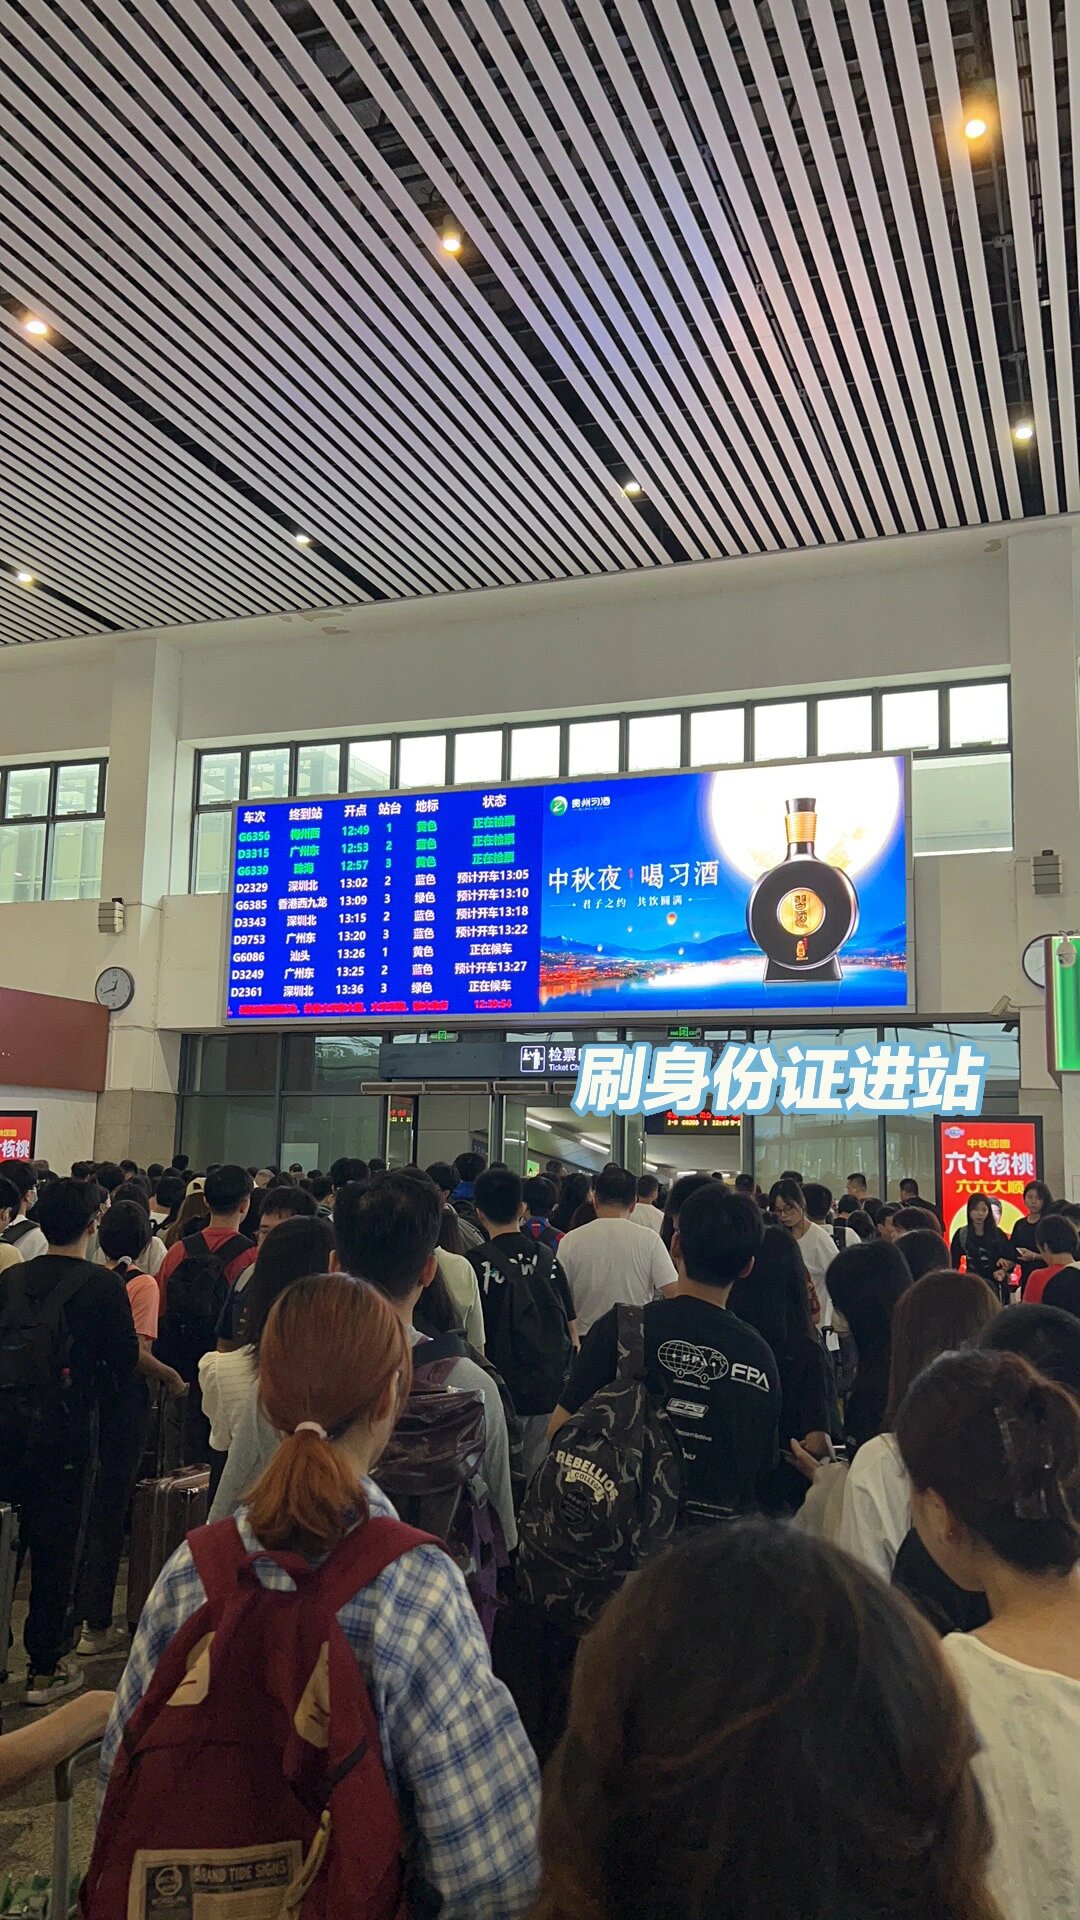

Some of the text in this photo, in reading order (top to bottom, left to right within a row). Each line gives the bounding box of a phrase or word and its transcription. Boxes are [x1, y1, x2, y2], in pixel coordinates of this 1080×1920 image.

[243, 794, 506, 824] 车次 终到站 开点 站台 地标 状态
[238, 831, 270, 842] G6356
[342, 825, 369, 836] 12:49
[386, 823, 392, 832] 1
[473, 815, 515, 829] 正在检票
[237, 848, 269, 859] D3315
[290, 844, 320, 858] 广州东
[342, 842, 369, 854] 12:53
[385, 840, 393, 851] 2
[472, 833, 515, 847] 正在检票
[237, 865, 269, 876] G6339
[341, 860, 368, 871] 12:57
[384, 858, 392, 868] 3
[472, 851, 515, 865] 正在检票
[236, 869, 529, 894] D2329 深圳北 13:02 2 蓝色 预计开车13:05
[549, 860, 719, 894] 中秋夜 喝习酒
[235, 887, 529, 910] G6385 香港西九龙 13:09 3 绿色 预计开车13:10
[583, 898, 627, 909] 君子之约
[234, 906, 528, 928] D3343 深圳北 13:15 2 蓝色 预计开车13:18
[233, 924, 528, 945] D9753 广州东 13:20 3 蓝色 预计开车13:22
[233, 942, 512, 962] G6086 汕头 13:26 1 黄色 正在候车
[231, 961, 527, 980] D3249 广州东 13:25 2 蓝色 预计开车13:27
[230, 979, 511, 998] D2361 深圳北 13:36 3 绿色 正在候车
[548, 1046, 582, 1062] 检票
[0, 1139, 30, 1158] 核桃
[945, 1151, 1034, 1176] 六个核桃
[956, 1179, 1024, 1194] 六六大顺
[731, 1363, 770, 1390] FPA
